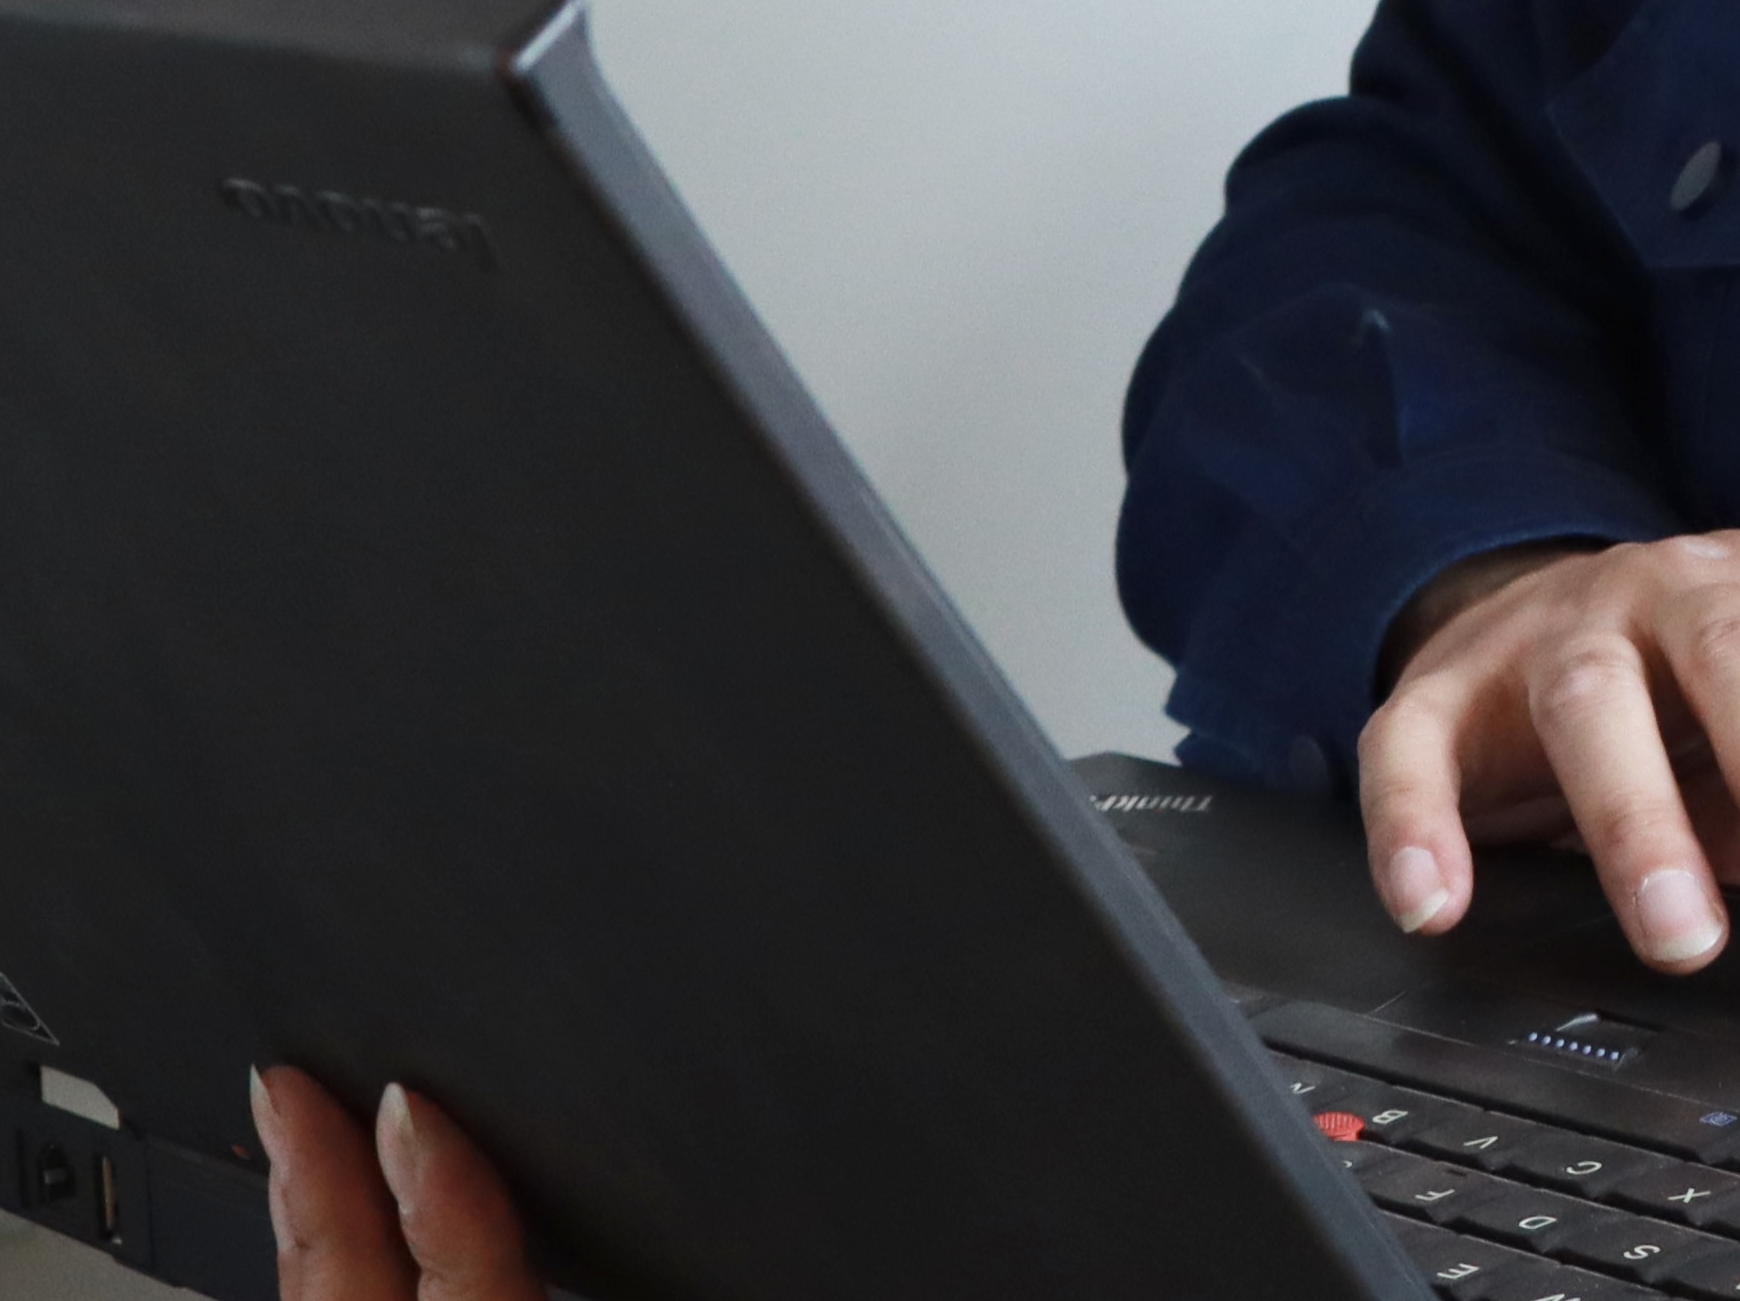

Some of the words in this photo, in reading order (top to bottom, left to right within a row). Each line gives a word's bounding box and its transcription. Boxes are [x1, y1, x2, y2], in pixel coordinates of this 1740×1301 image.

[1090, 794, 1212, 813] ThinkP
[1372, 1109, 1408, 1125] B
[1463, 1136, 1498, 1149] V
[1566, 1161, 1602, 1175] C
[1415, 1189, 1455, 1202] F
[1667, 1187, 1711, 1204] X
[1518, 1215, 1557, 1230] D
[1623, 1244, 1661, 1260] S
[1436, 1263, 1480, 1280] E
